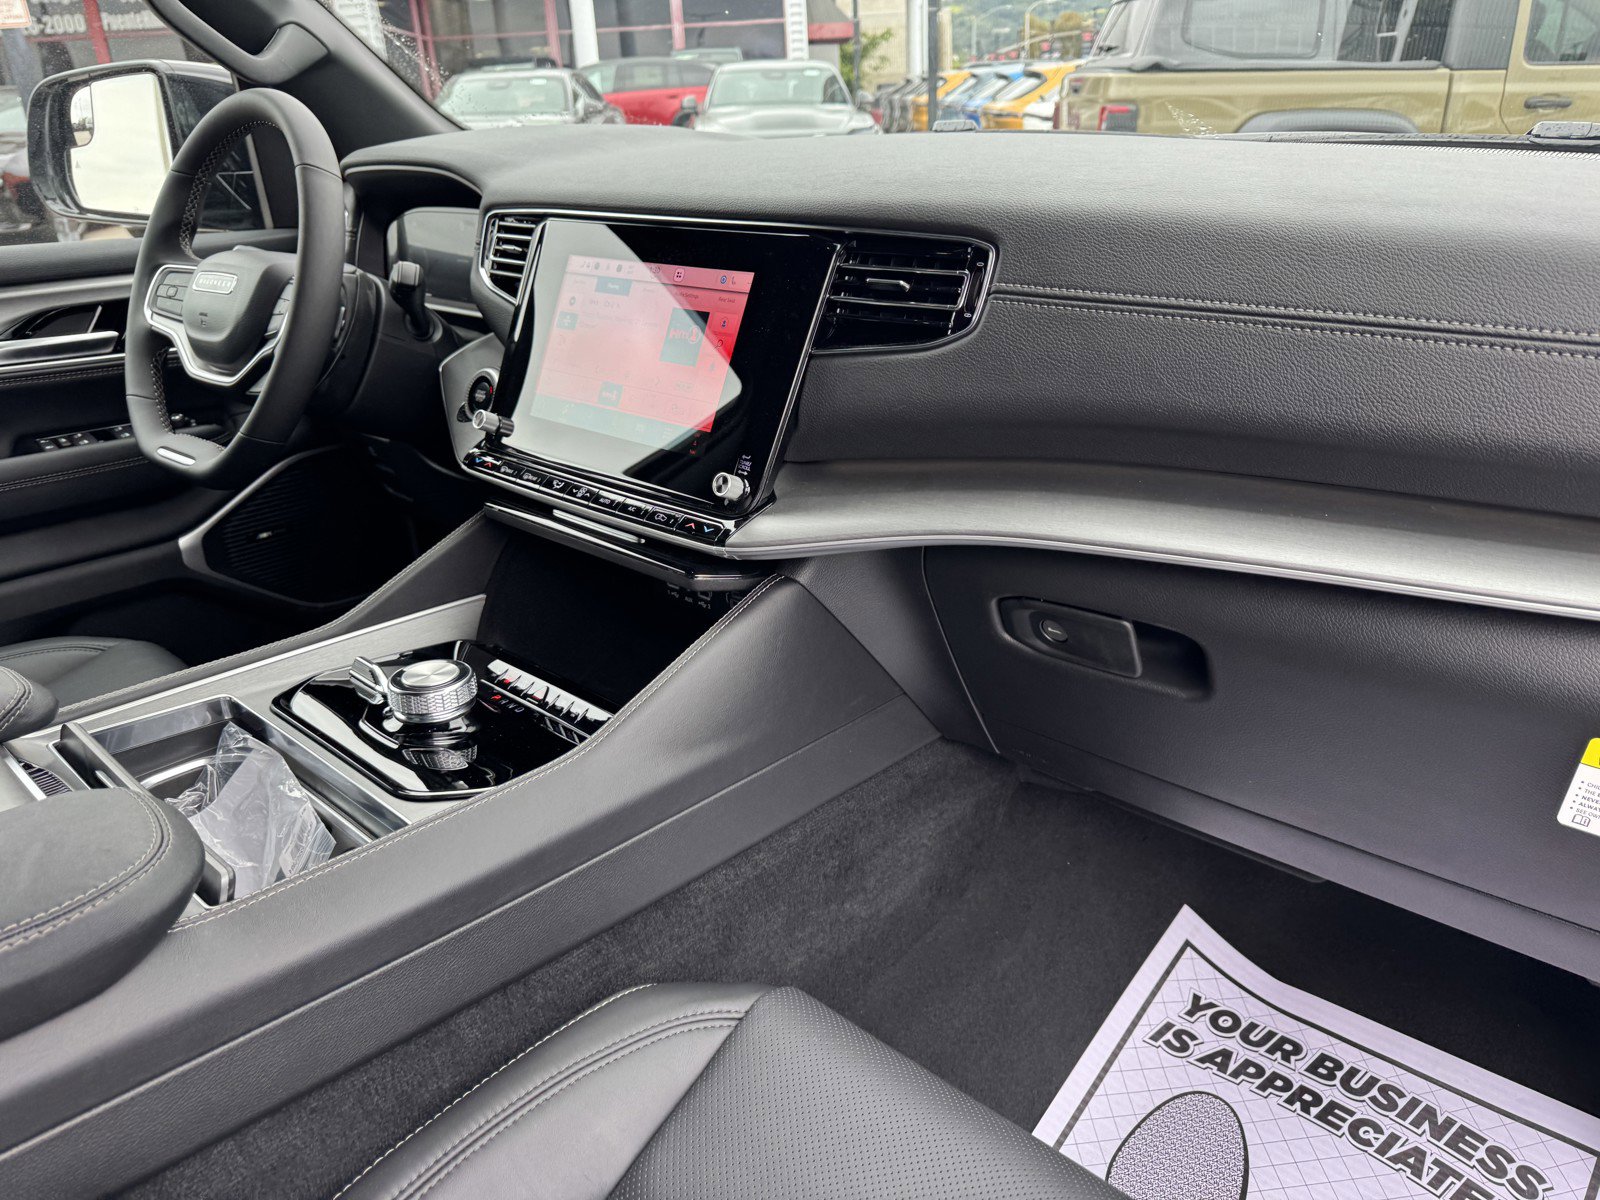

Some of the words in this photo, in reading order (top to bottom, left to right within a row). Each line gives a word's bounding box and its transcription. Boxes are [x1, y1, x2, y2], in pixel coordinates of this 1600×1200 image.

[1146, 1019, 1202, 1056] IS
[1180, 990, 1306, 1070] YOUR
[1302, 1048, 1552, 1200] BUSINESS
